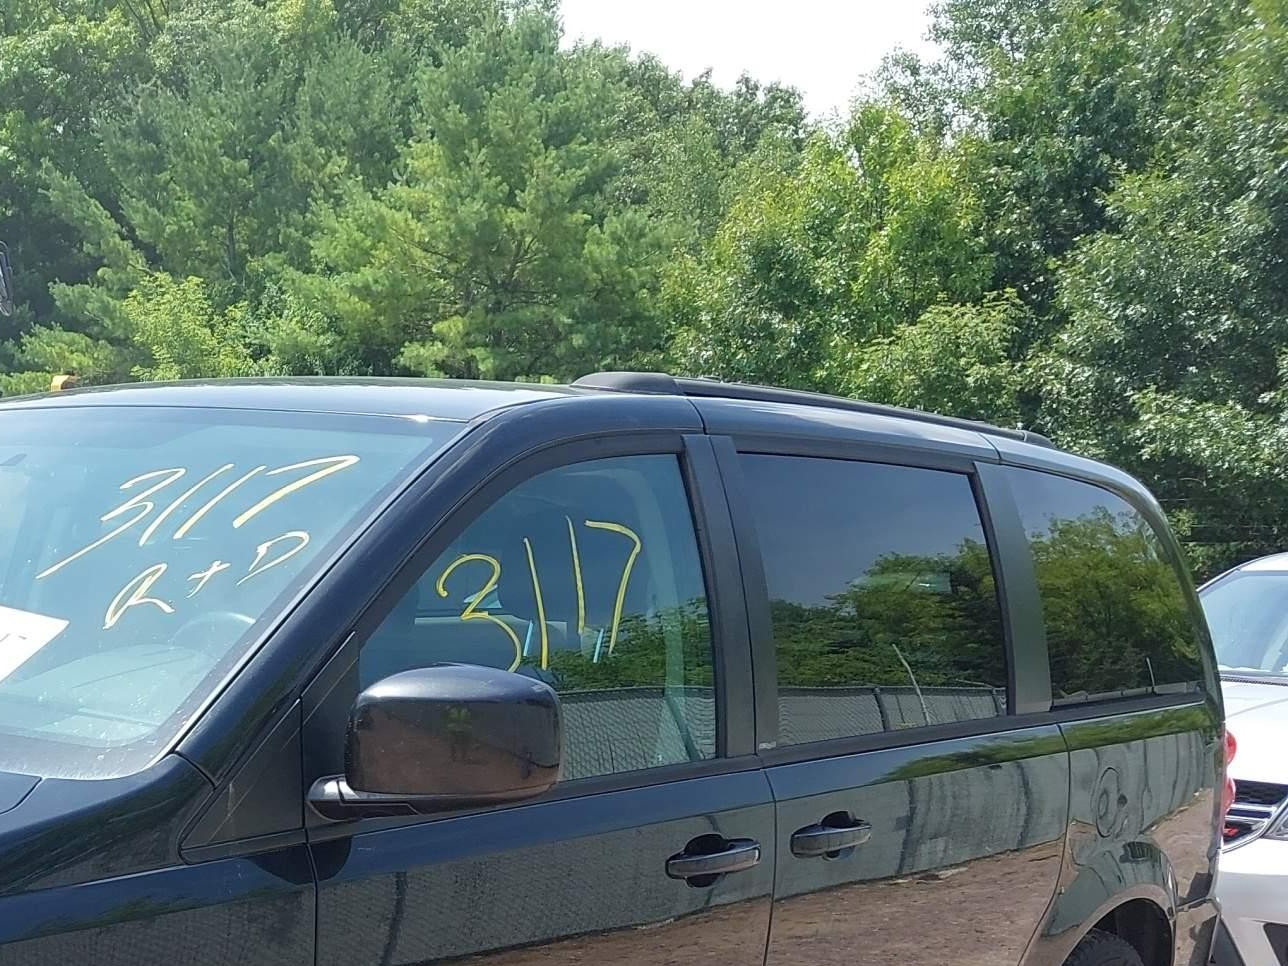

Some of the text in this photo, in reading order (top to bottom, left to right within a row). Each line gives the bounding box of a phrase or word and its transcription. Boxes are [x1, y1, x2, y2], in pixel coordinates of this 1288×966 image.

[35, 455, 360, 579] 3117
[103, 563, 175, 630] R
[236, 531, 310, 585] D
[436, 516, 642, 672] 3117
